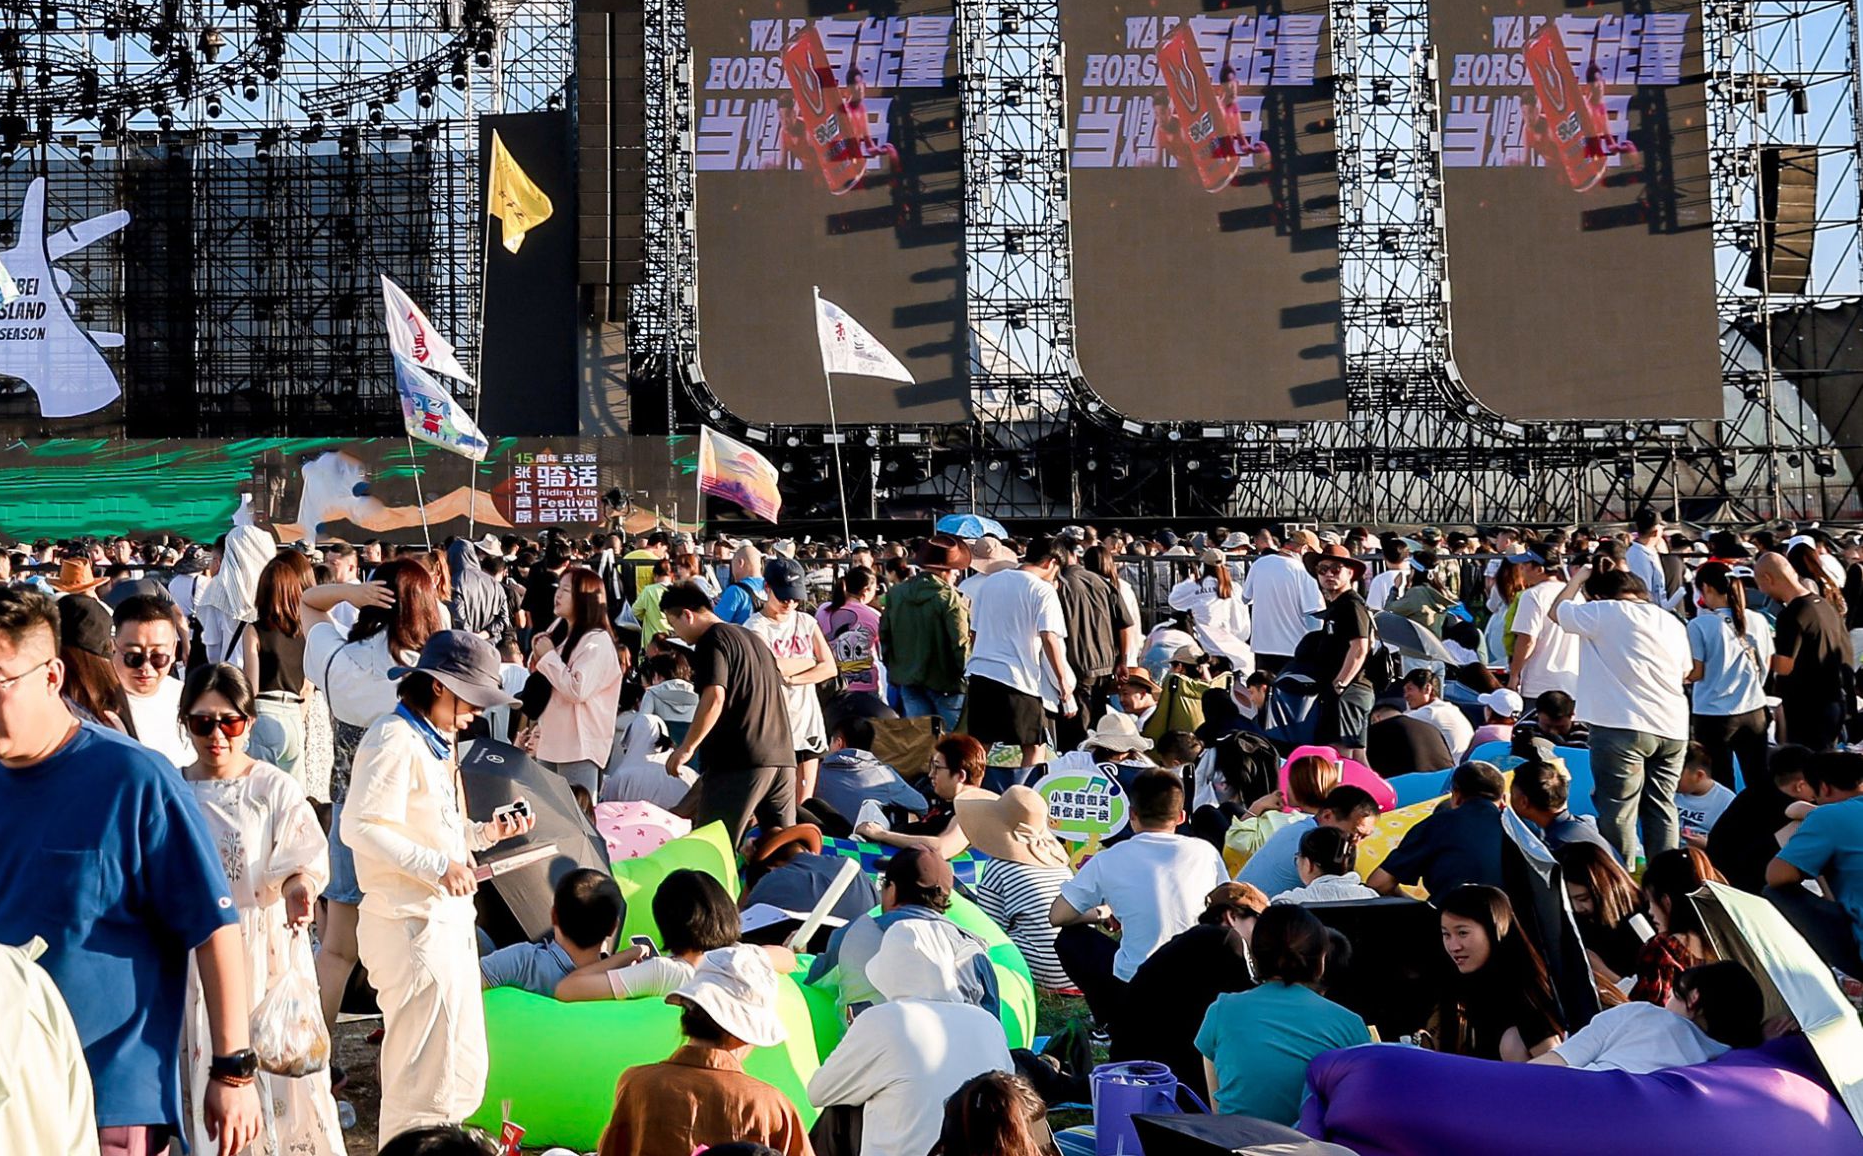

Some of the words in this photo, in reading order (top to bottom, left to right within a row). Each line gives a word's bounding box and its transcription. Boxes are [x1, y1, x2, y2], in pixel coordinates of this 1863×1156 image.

[816, 16, 955, 87] 有能量
[1189, 14, 1325, 86] 有能量
[1555, 13, 1690, 84] 有能量
[705, 57, 789, 89] HORS
[1082, 54, 1165, 86] HORS
[1450, 54, 1534, 86] HORS
[537, 465, 597, 487] 骑活
[515, 466, 532, 523] 张北草原
[538, 489, 573, 497] Riding
[577, 488, 598, 496] Life
[538, 497, 597, 508] Festival
[539, 509, 598, 522] 音乐节
